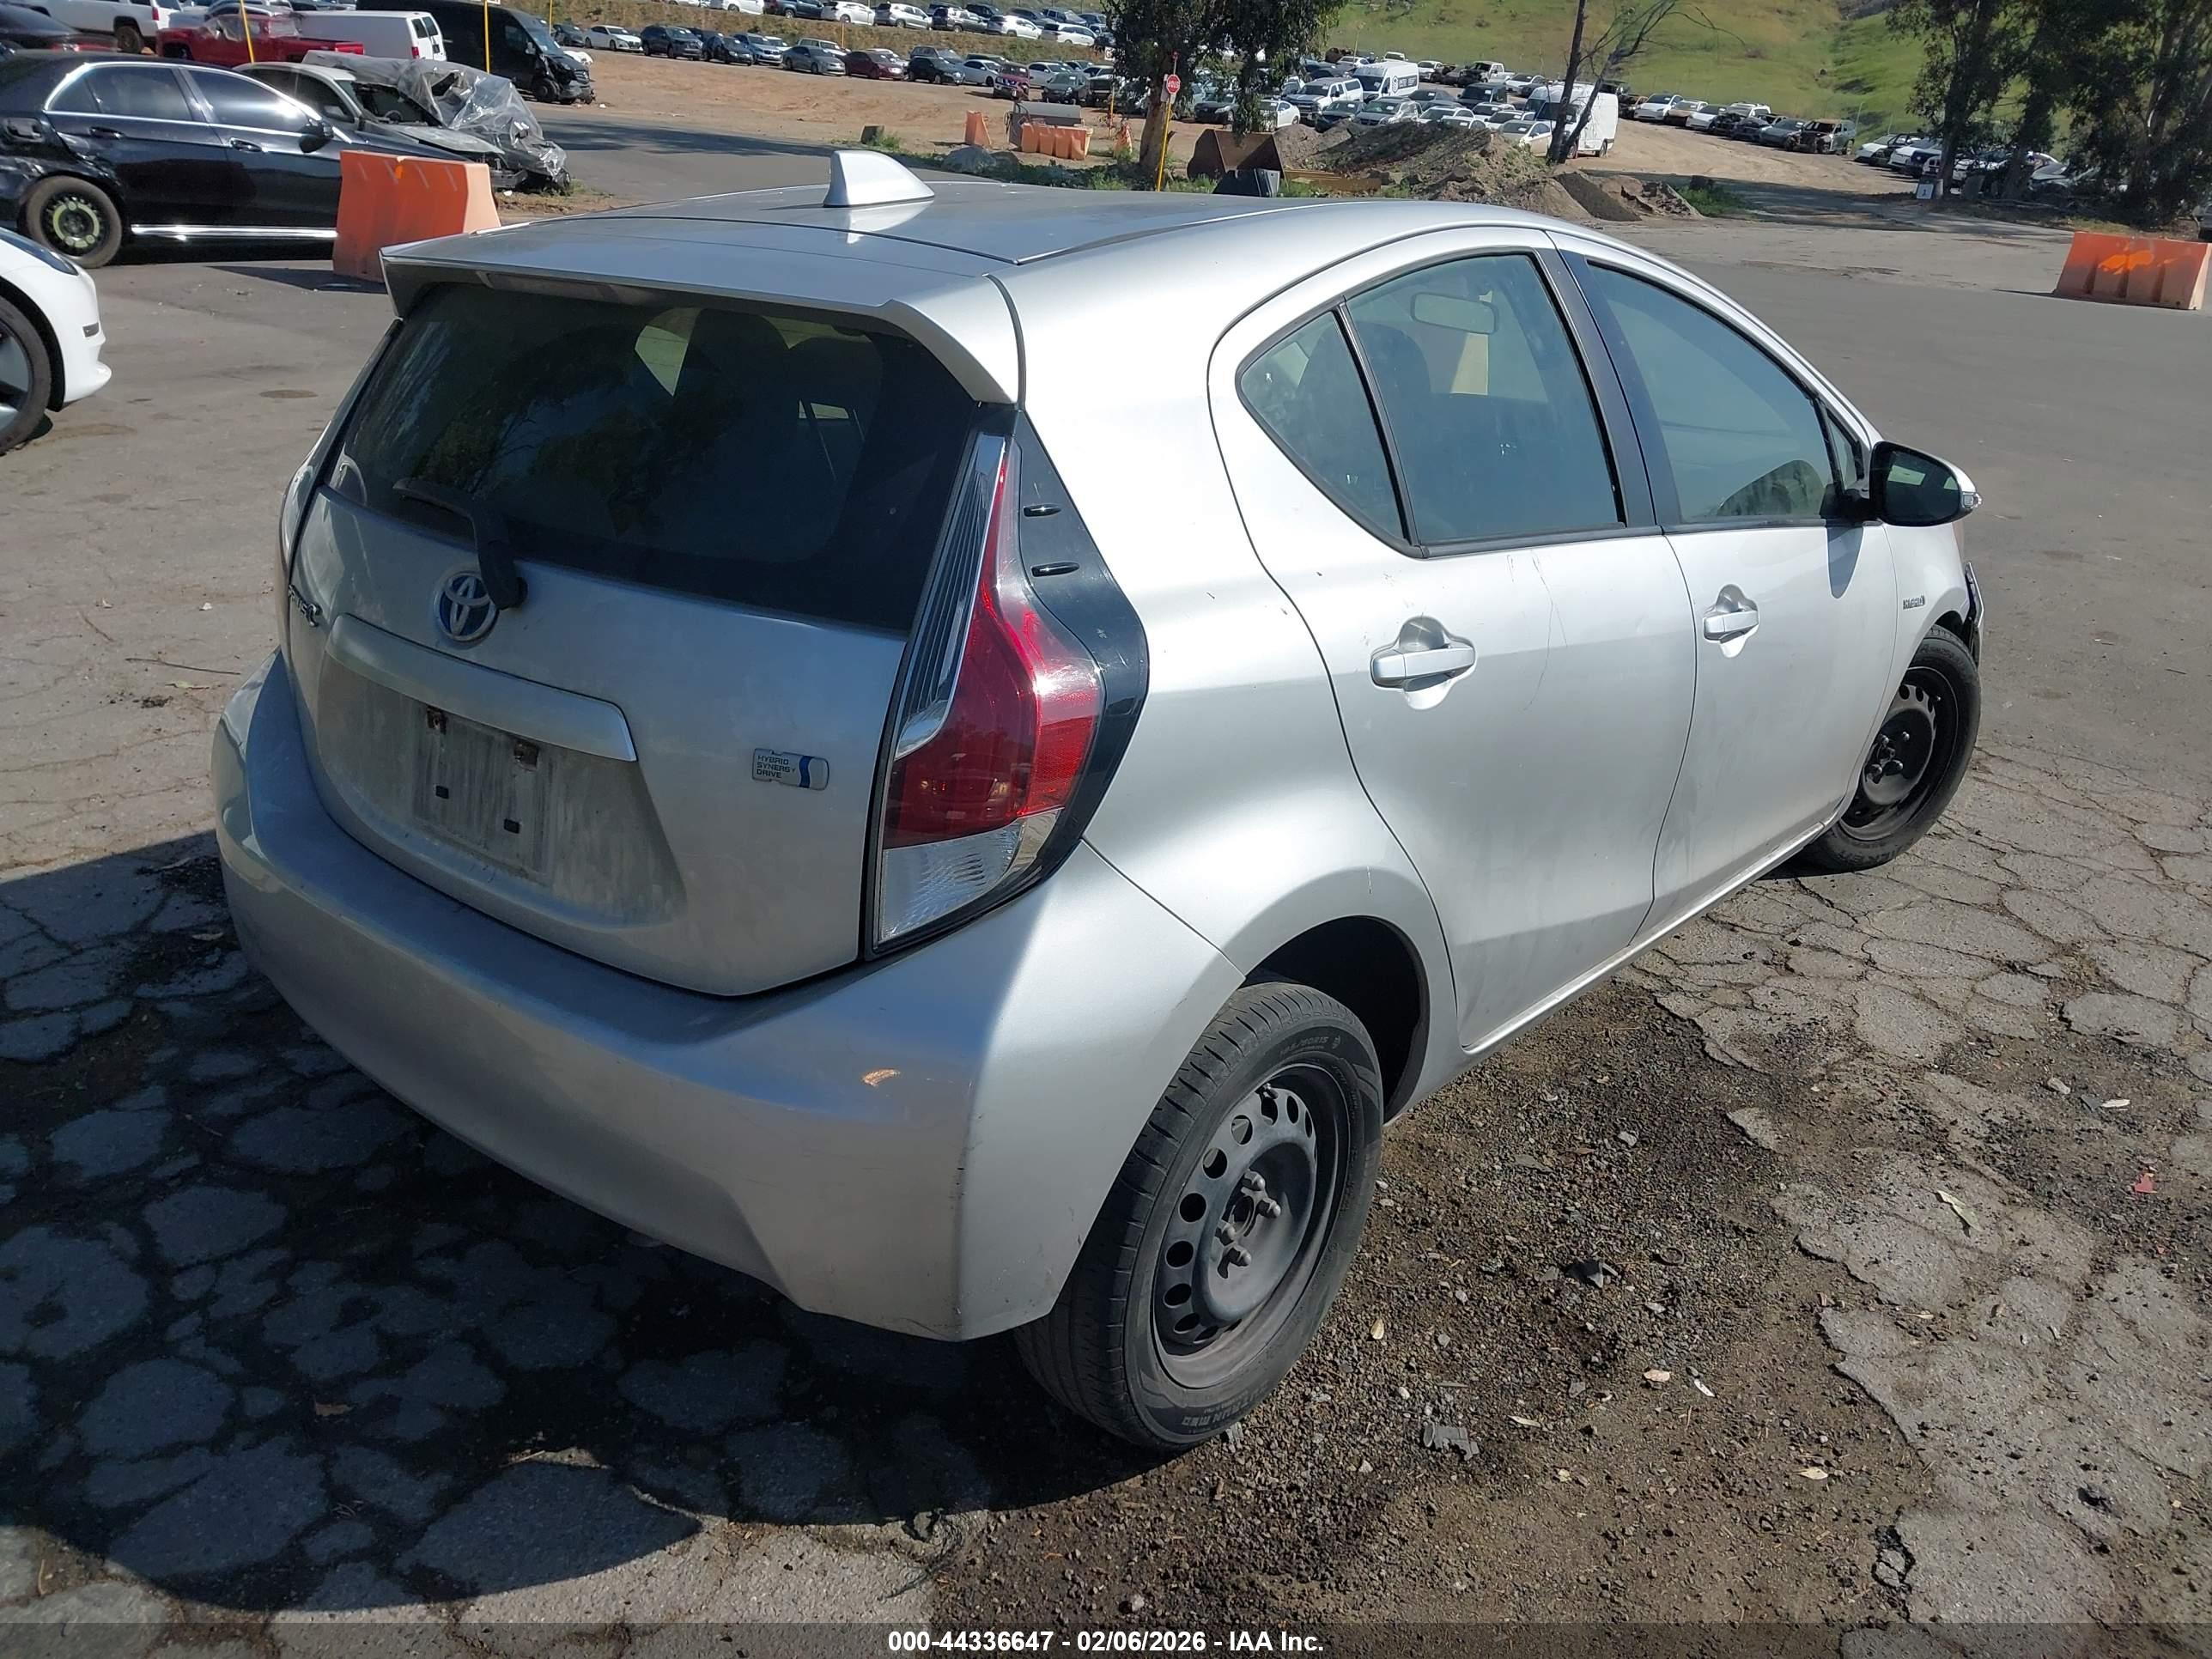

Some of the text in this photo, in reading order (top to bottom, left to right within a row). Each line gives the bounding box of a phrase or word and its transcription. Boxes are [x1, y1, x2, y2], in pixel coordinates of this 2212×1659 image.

[757, 755, 789, 765] HYBRID
[757, 762, 796, 773] SYNERGY
[756, 769, 782, 778] DRIVE
